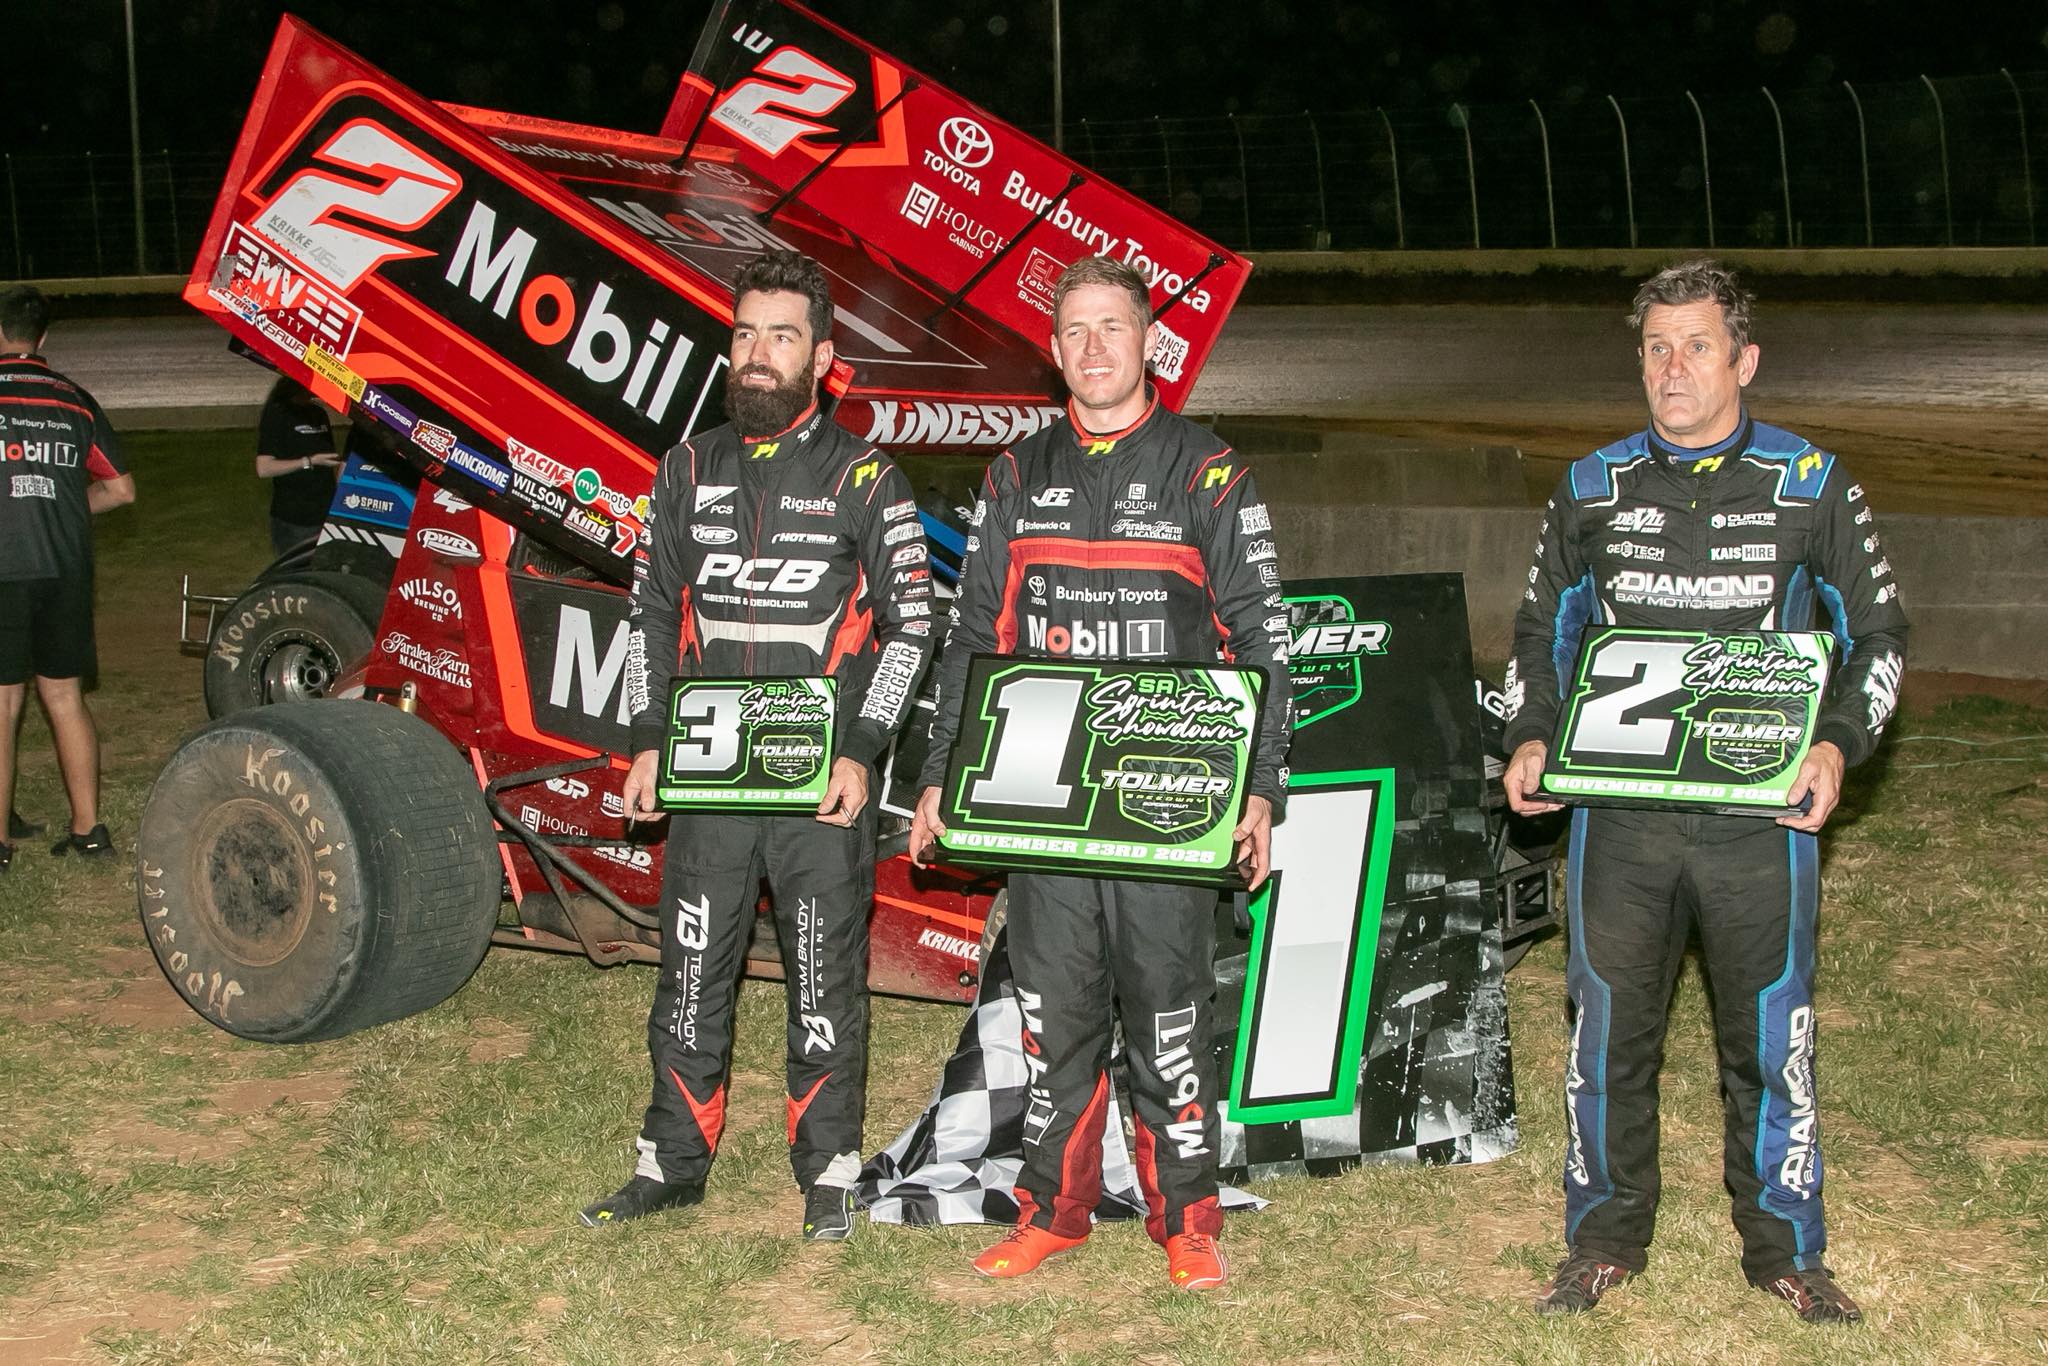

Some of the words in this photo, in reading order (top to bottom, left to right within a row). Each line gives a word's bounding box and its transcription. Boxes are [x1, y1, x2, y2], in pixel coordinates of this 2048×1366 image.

[709, 46, 856, 158] 2
[488, 136, 608, 168] Bunbury
[922, 150, 980, 196] TOYOTA
[250, 118, 462, 295] 2
[269, 215, 313, 249] KRIKKE
[590, 197, 800, 252] Mobil
[948, 233, 984, 259] CABINETS
[277, 310, 303, 333] PTY
[446, 201, 695, 423] Mobil
[326, 371, 348, 391] HIRING
[377, 401, 412, 428] HOOSIER
[417, 433, 448, 453] PASS
[450, 447, 509, 489] KINCROME
[514, 472, 567, 512] WILSON
[577, 477, 598, 495] my
[599, 488, 630, 510] moto
[360, 496, 394, 512] SPRINT
[710, 505, 734, 514] PCS
[780, 496, 836, 513] Rigsafe
[1114, 500, 1157, 511] HOUGH
[1728, 512, 1776, 521] CURTIS
[567, 506, 611, 543] King
[1125, 530, 1182, 541] MACADAMIAS
[422, 530, 468, 551] PWR
[1711, 547, 1742, 560] KAIS
[1745, 547, 1774, 558] HIRE
[696, 553, 831, 593] PCB
[1615, 570, 1774, 598] DIAMOND
[398, 578, 463, 621] WILSON
[413, 598, 449, 616] BREWING
[750, 599, 809, 609] DEMOLITION
[1055, 585, 1116, 606] Bunbury
[1118, 588, 1168, 605] Toyota
[1615, 592, 1646, 603] BAY
[1648, 596, 1773, 609] MOTORSPORT
[1027, 614, 1119, 656] Mobil
[1727, 641, 1758, 654] SA
[399, 654, 473, 689] MACADAMIAS
[1683, 642, 1816, 676] Sprintcar
[766, 686, 788, 696] SA
[865, 643, 902, 720] PERFORMANCE
[877, 647, 920, 728] RACEGEAR
[1138, 678, 1174, 694] SA
[1685, 668, 1817, 698] Showdown
[740, 687, 826, 709] Sprintcar
[1091, 680, 1241, 722] Sprintcar
[1571, 640, 1696, 756] 2
[674, 689, 745, 771] 3
[741, 705, 831, 727] Showdown
[1092, 705, 1245, 741] Showdown
[970, 677, 1084, 808] 1
[1692, 721, 1802, 742] TOLMER
[752, 744, 823, 759] TOLMER
[666, 789, 740, 800] NOVEMBER
[744, 790, 780, 800] 23RD
[783, 790, 819, 800] 2025
[1101, 769, 1232, 798] TOLMER
[1553, 777, 1667, 795] NOVEMBER
[1670, 784, 1728, 799] 23RD
[1730, 787, 1787, 802] 2025
[950, 832, 1078, 854] NOVEMBER
[1084, 842, 1148, 859] 23RD
[1153, 846, 1216, 864] 2025
[627, 862, 650, 875] DOCTOR
[797, 897, 810, 963] BRADY
[1240, 779, 1381, 1107] 1
[799, 963, 811, 1011] TEAM
[1154, 1042, 1210, 1160] Mobil
[1780, 1006, 1816, 1187] DIAMOND
